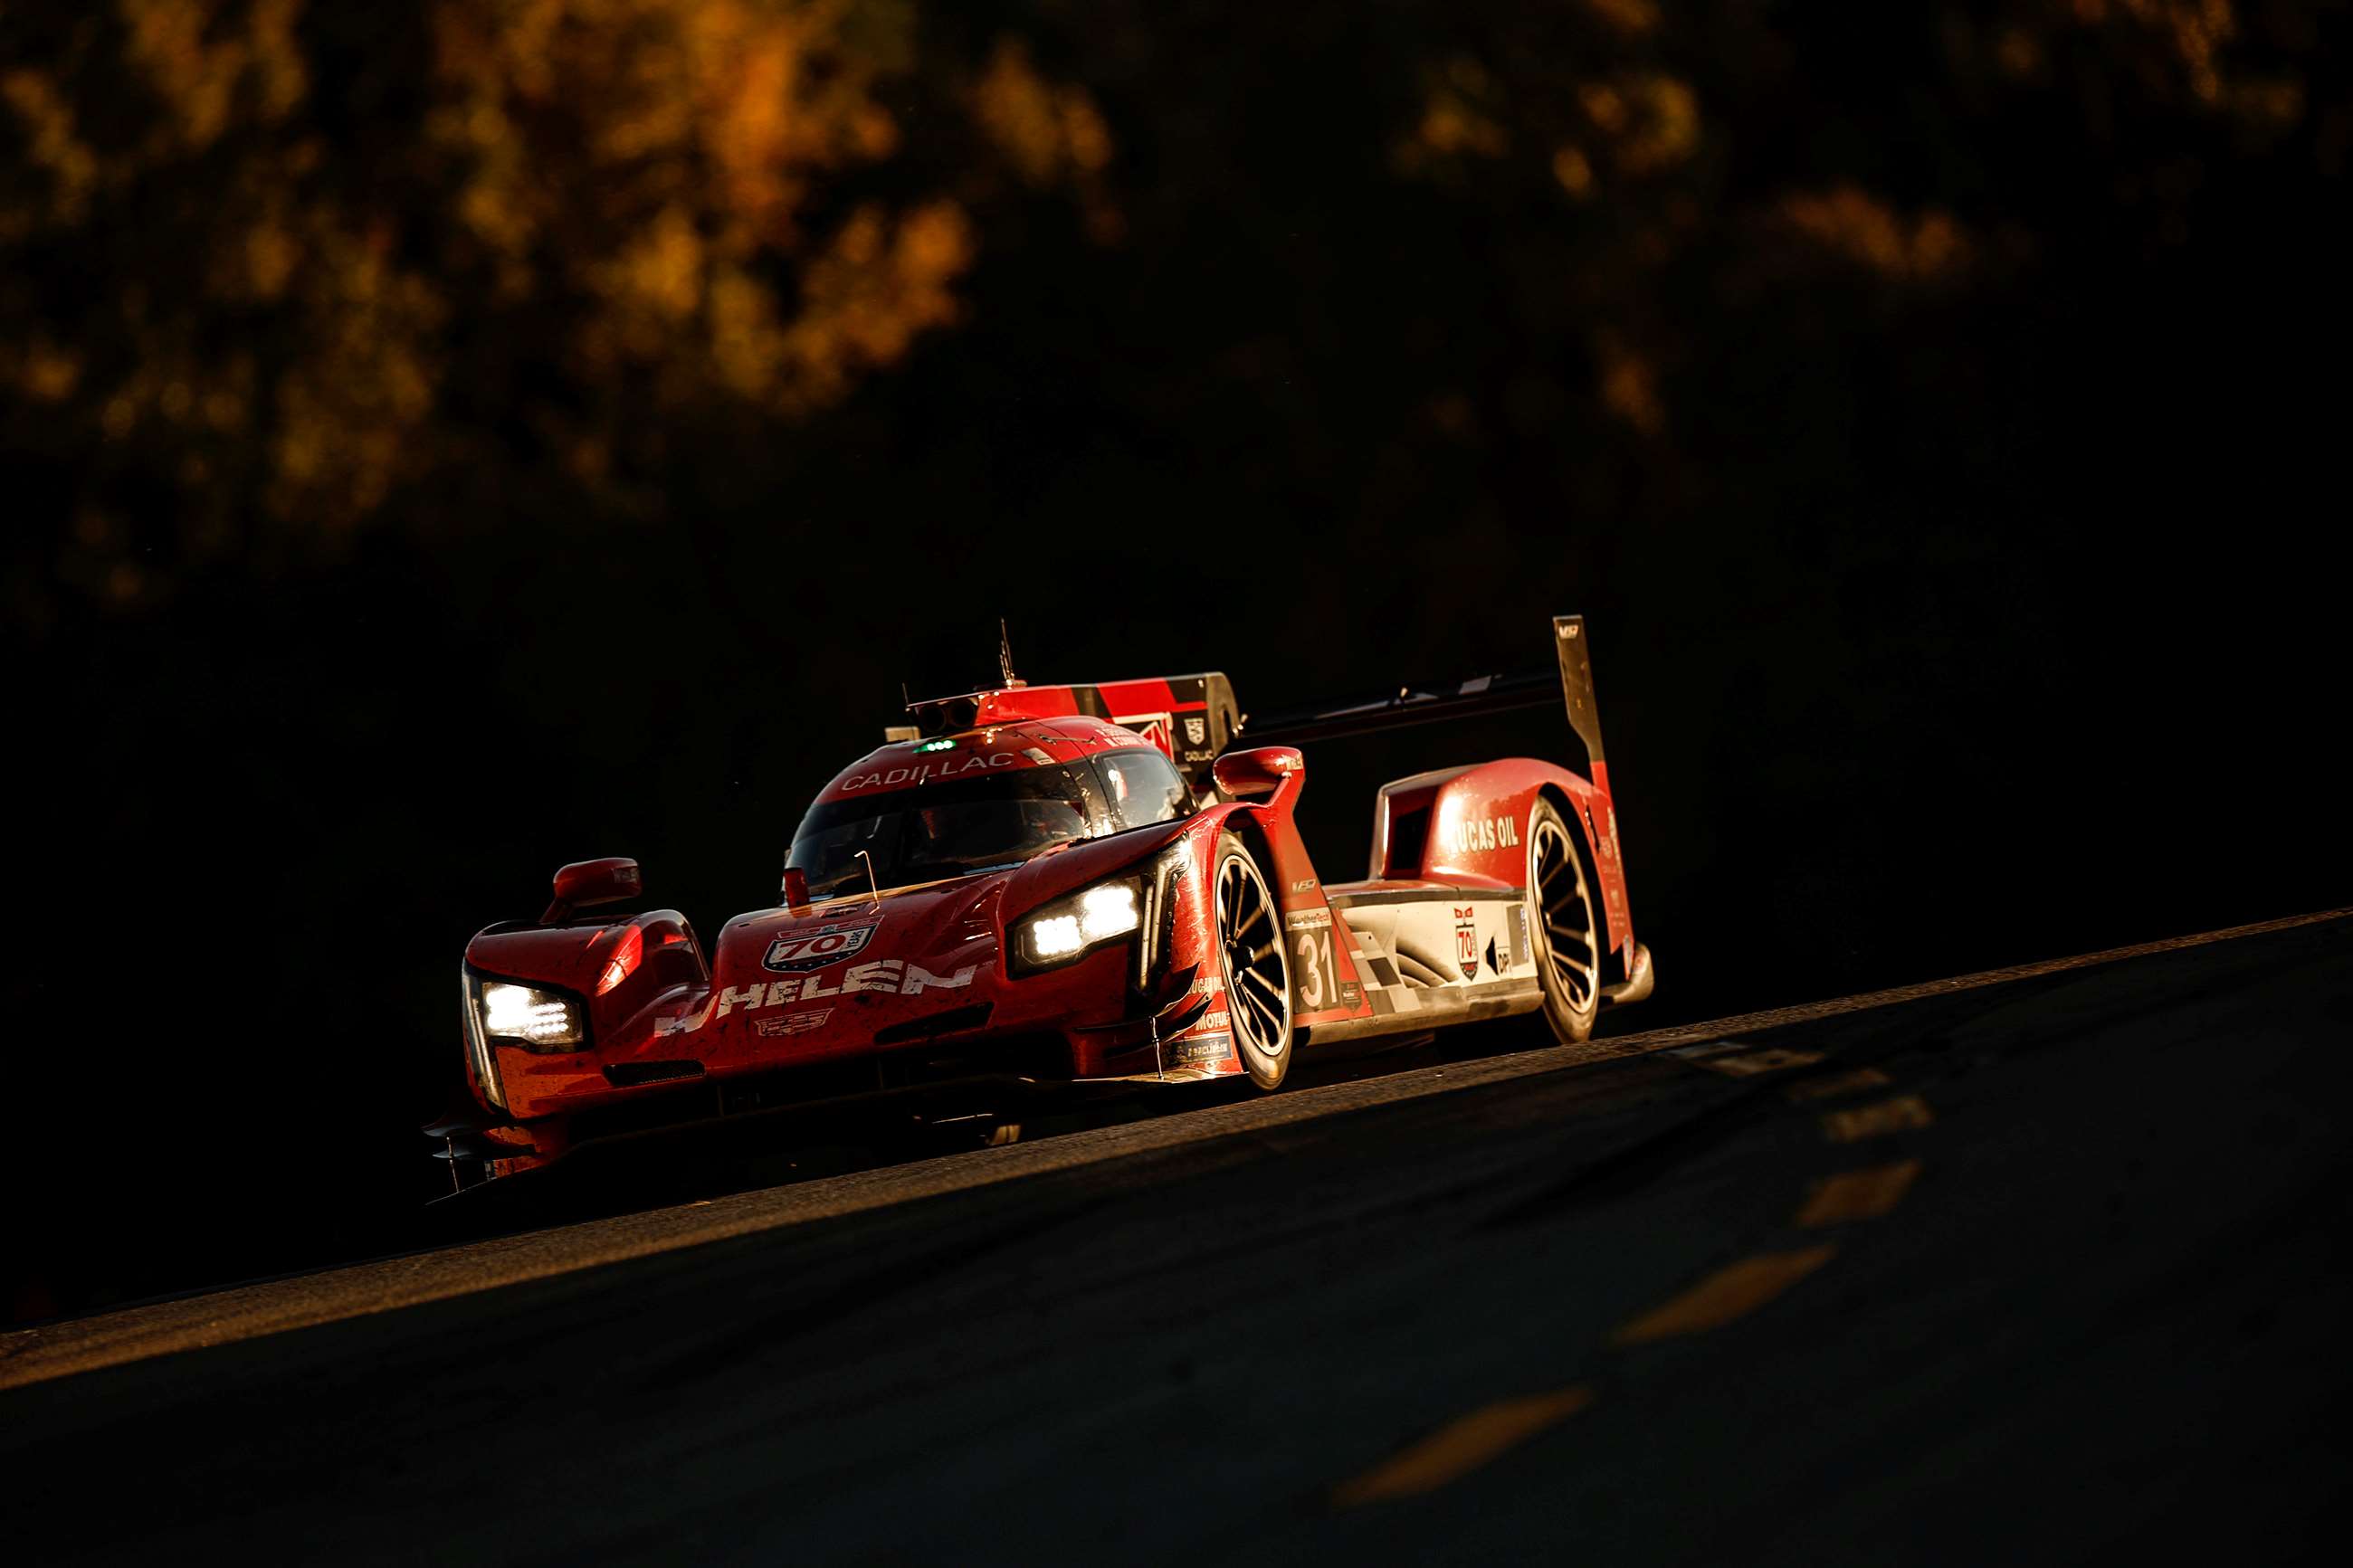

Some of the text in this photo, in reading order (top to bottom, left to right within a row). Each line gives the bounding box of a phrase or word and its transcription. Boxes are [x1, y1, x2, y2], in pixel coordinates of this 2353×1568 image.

[841, 752, 1015, 792] CADILLAC
[1497, 815, 1519, 848] OIL
[779, 935, 846, 960] 70
[1457, 930, 1473, 959] 70
[1297, 931, 1338, 1008] 31
[653, 959, 977, 1039] WHELEN
